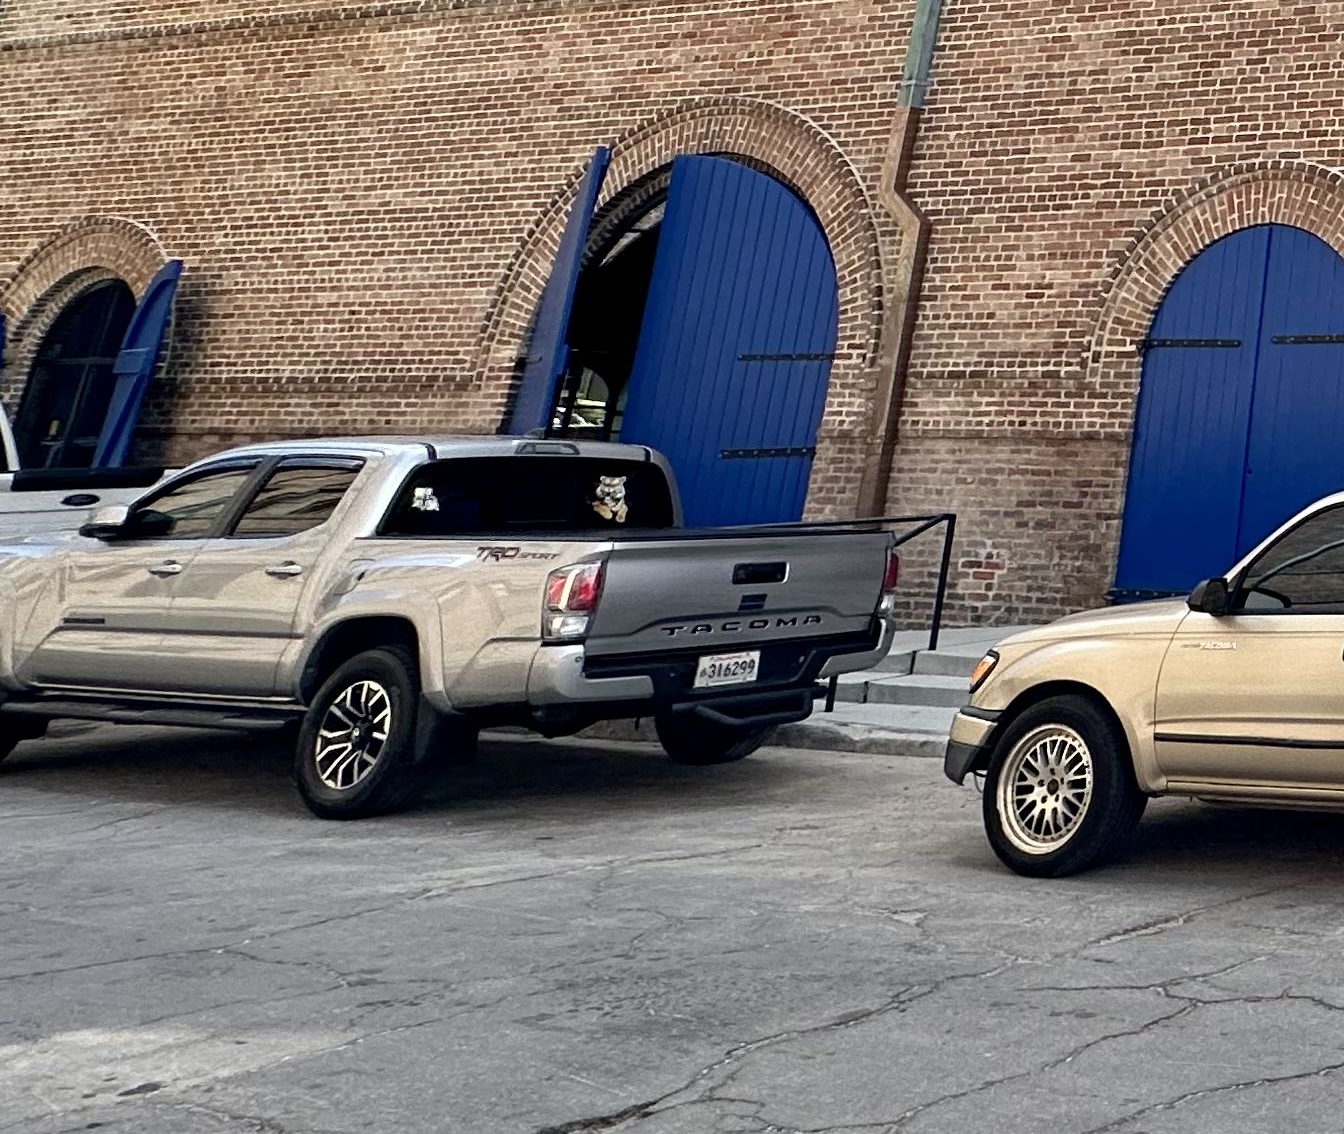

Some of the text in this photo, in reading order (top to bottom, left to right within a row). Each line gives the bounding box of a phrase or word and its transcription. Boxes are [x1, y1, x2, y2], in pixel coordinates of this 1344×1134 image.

[477, 547, 521, 562] TRD
[661, 615, 822, 637] TACOMA
[706, 658, 756, 680] 316299
